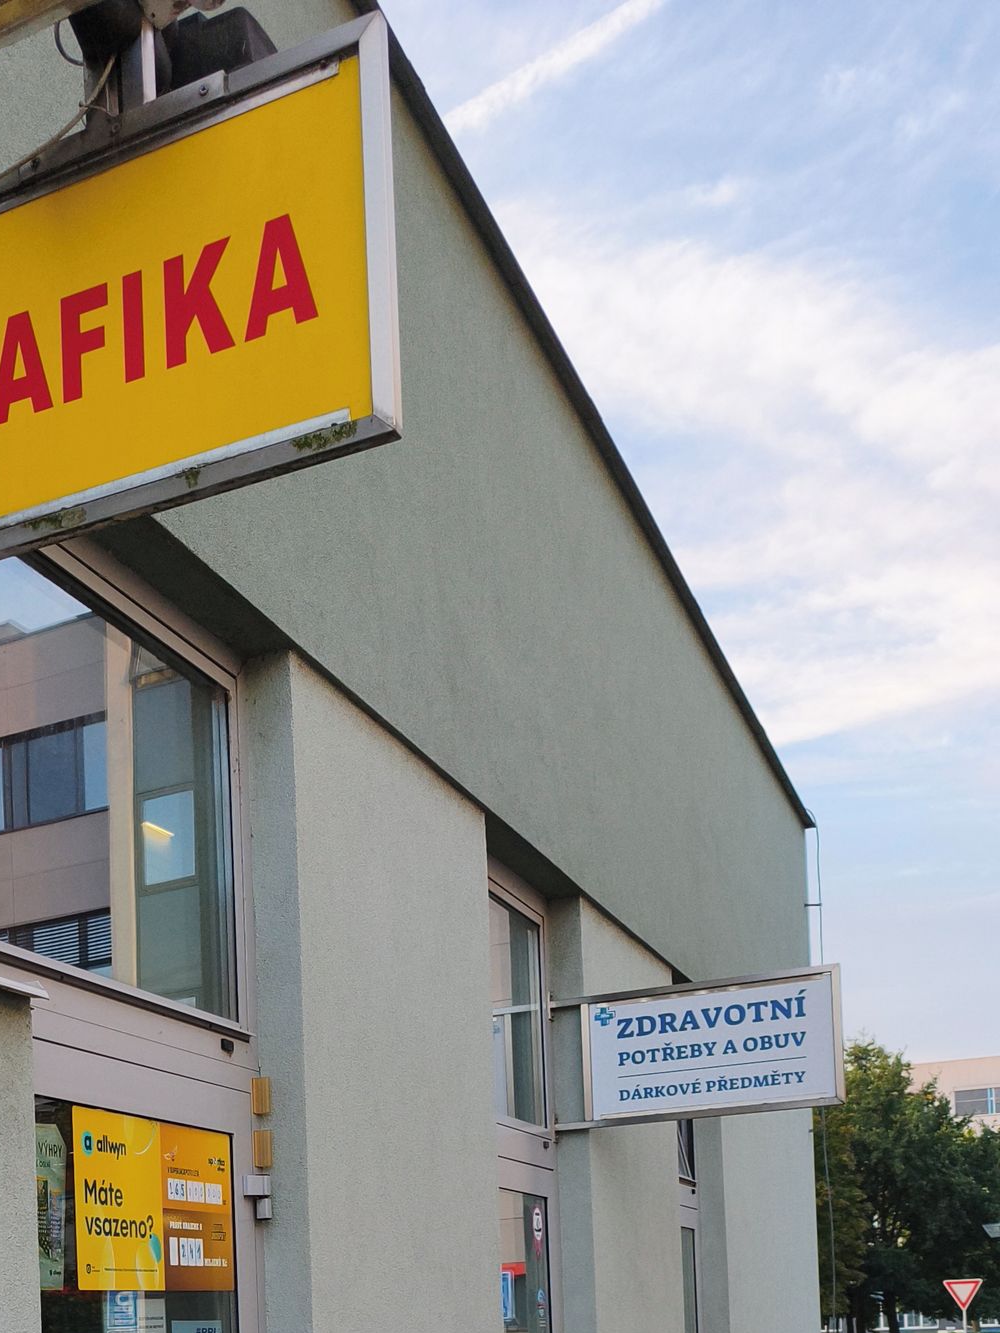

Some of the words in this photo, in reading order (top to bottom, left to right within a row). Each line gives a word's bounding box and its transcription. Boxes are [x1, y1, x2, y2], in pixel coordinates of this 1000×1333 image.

[616, 988, 807, 1039] ZDRAVOTNÍ
[617, 1041, 717, 1067] POTŘEBY
[722, 1039, 738, 1055] A
[742, 1031, 807, 1052] OBUV
[618, 1079, 702, 1102] DÁRKOVÉ
[706, 1070, 807, 1093] PŘEDMĚTY
[37, 1139, 63, 1158] VÝHRY
[96, 1134, 127, 1160] allwyn
[83, 1179, 123, 1208] Máte
[84, 1215, 154, 1239] vsazeno?
